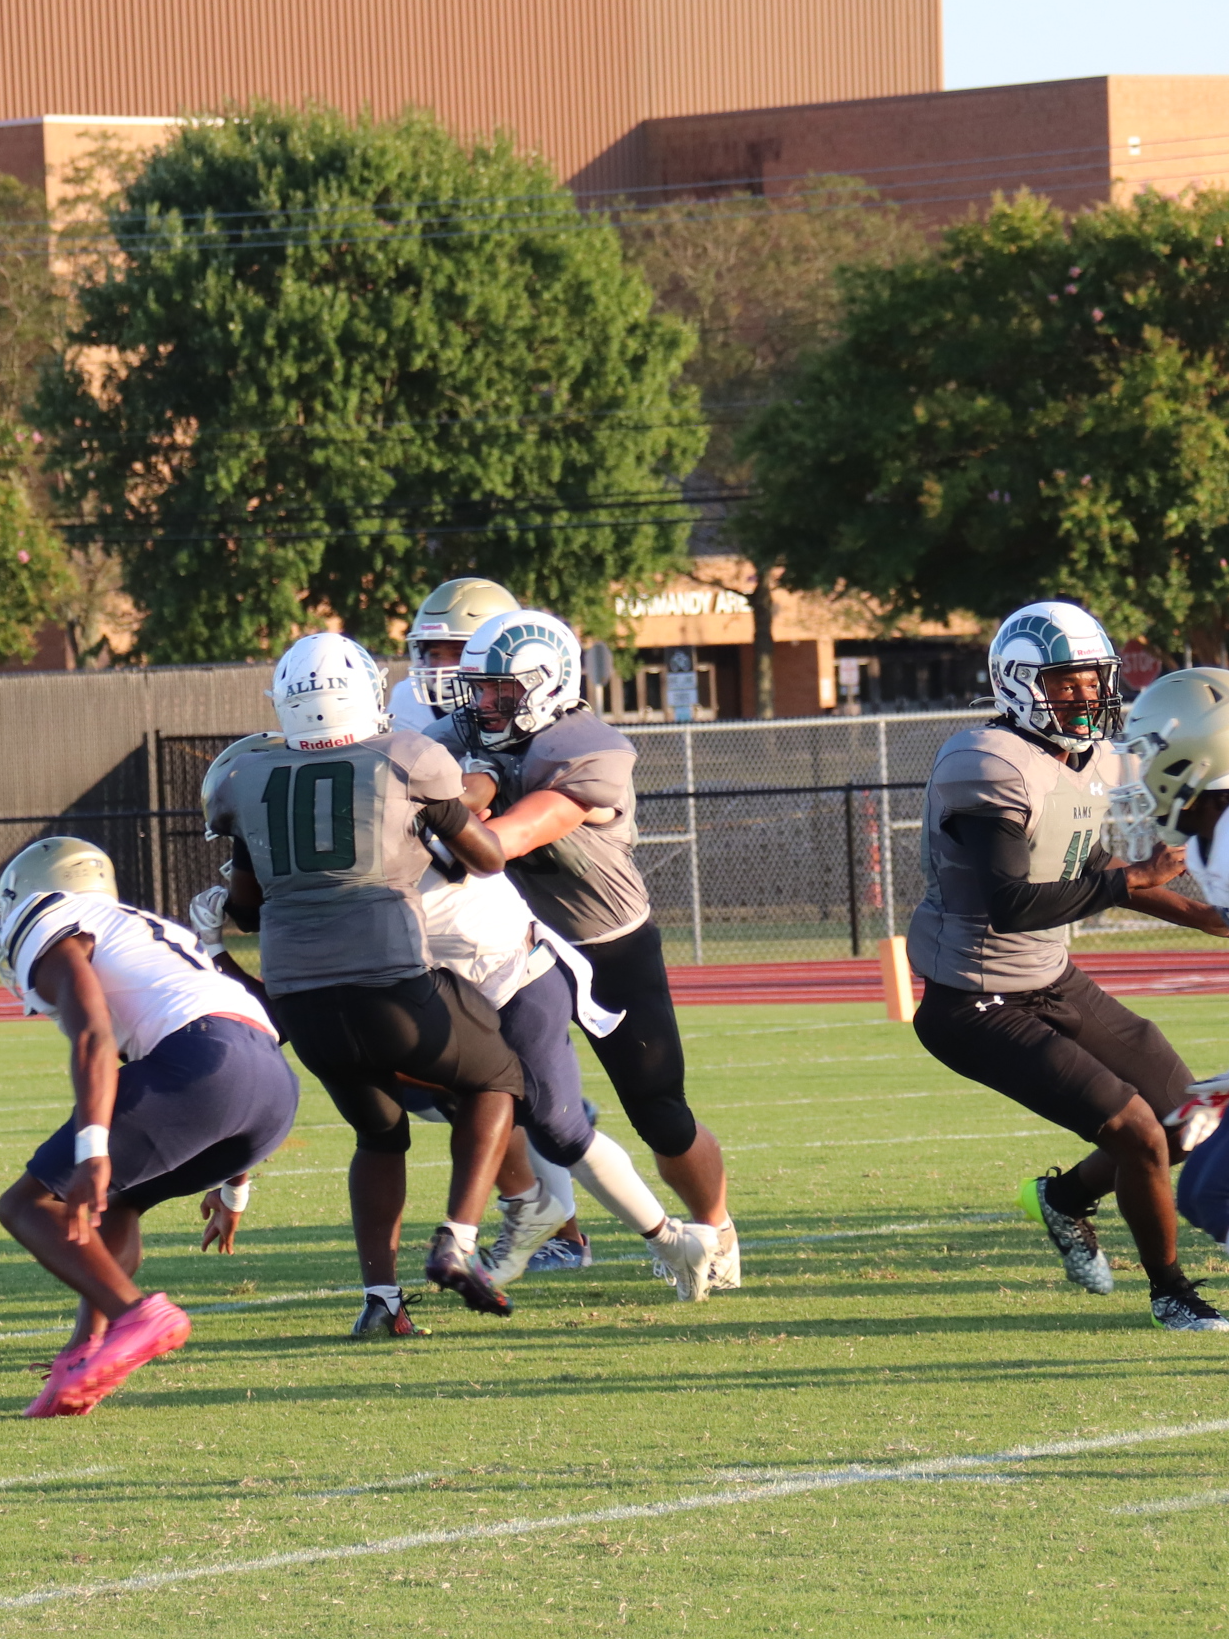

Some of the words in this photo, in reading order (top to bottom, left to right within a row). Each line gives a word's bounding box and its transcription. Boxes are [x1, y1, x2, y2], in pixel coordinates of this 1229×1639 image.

[714, 589, 754, 614] ARE
[1121, 650, 1156, 674] STOP
[285, 679, 323, 698] ALL
[327, 676, 348, 690] IN
[299, 733, 355, 751] Riddell
[260, 761, 357, 877] 10
[1073, 806, 1092, 820] RAMS
